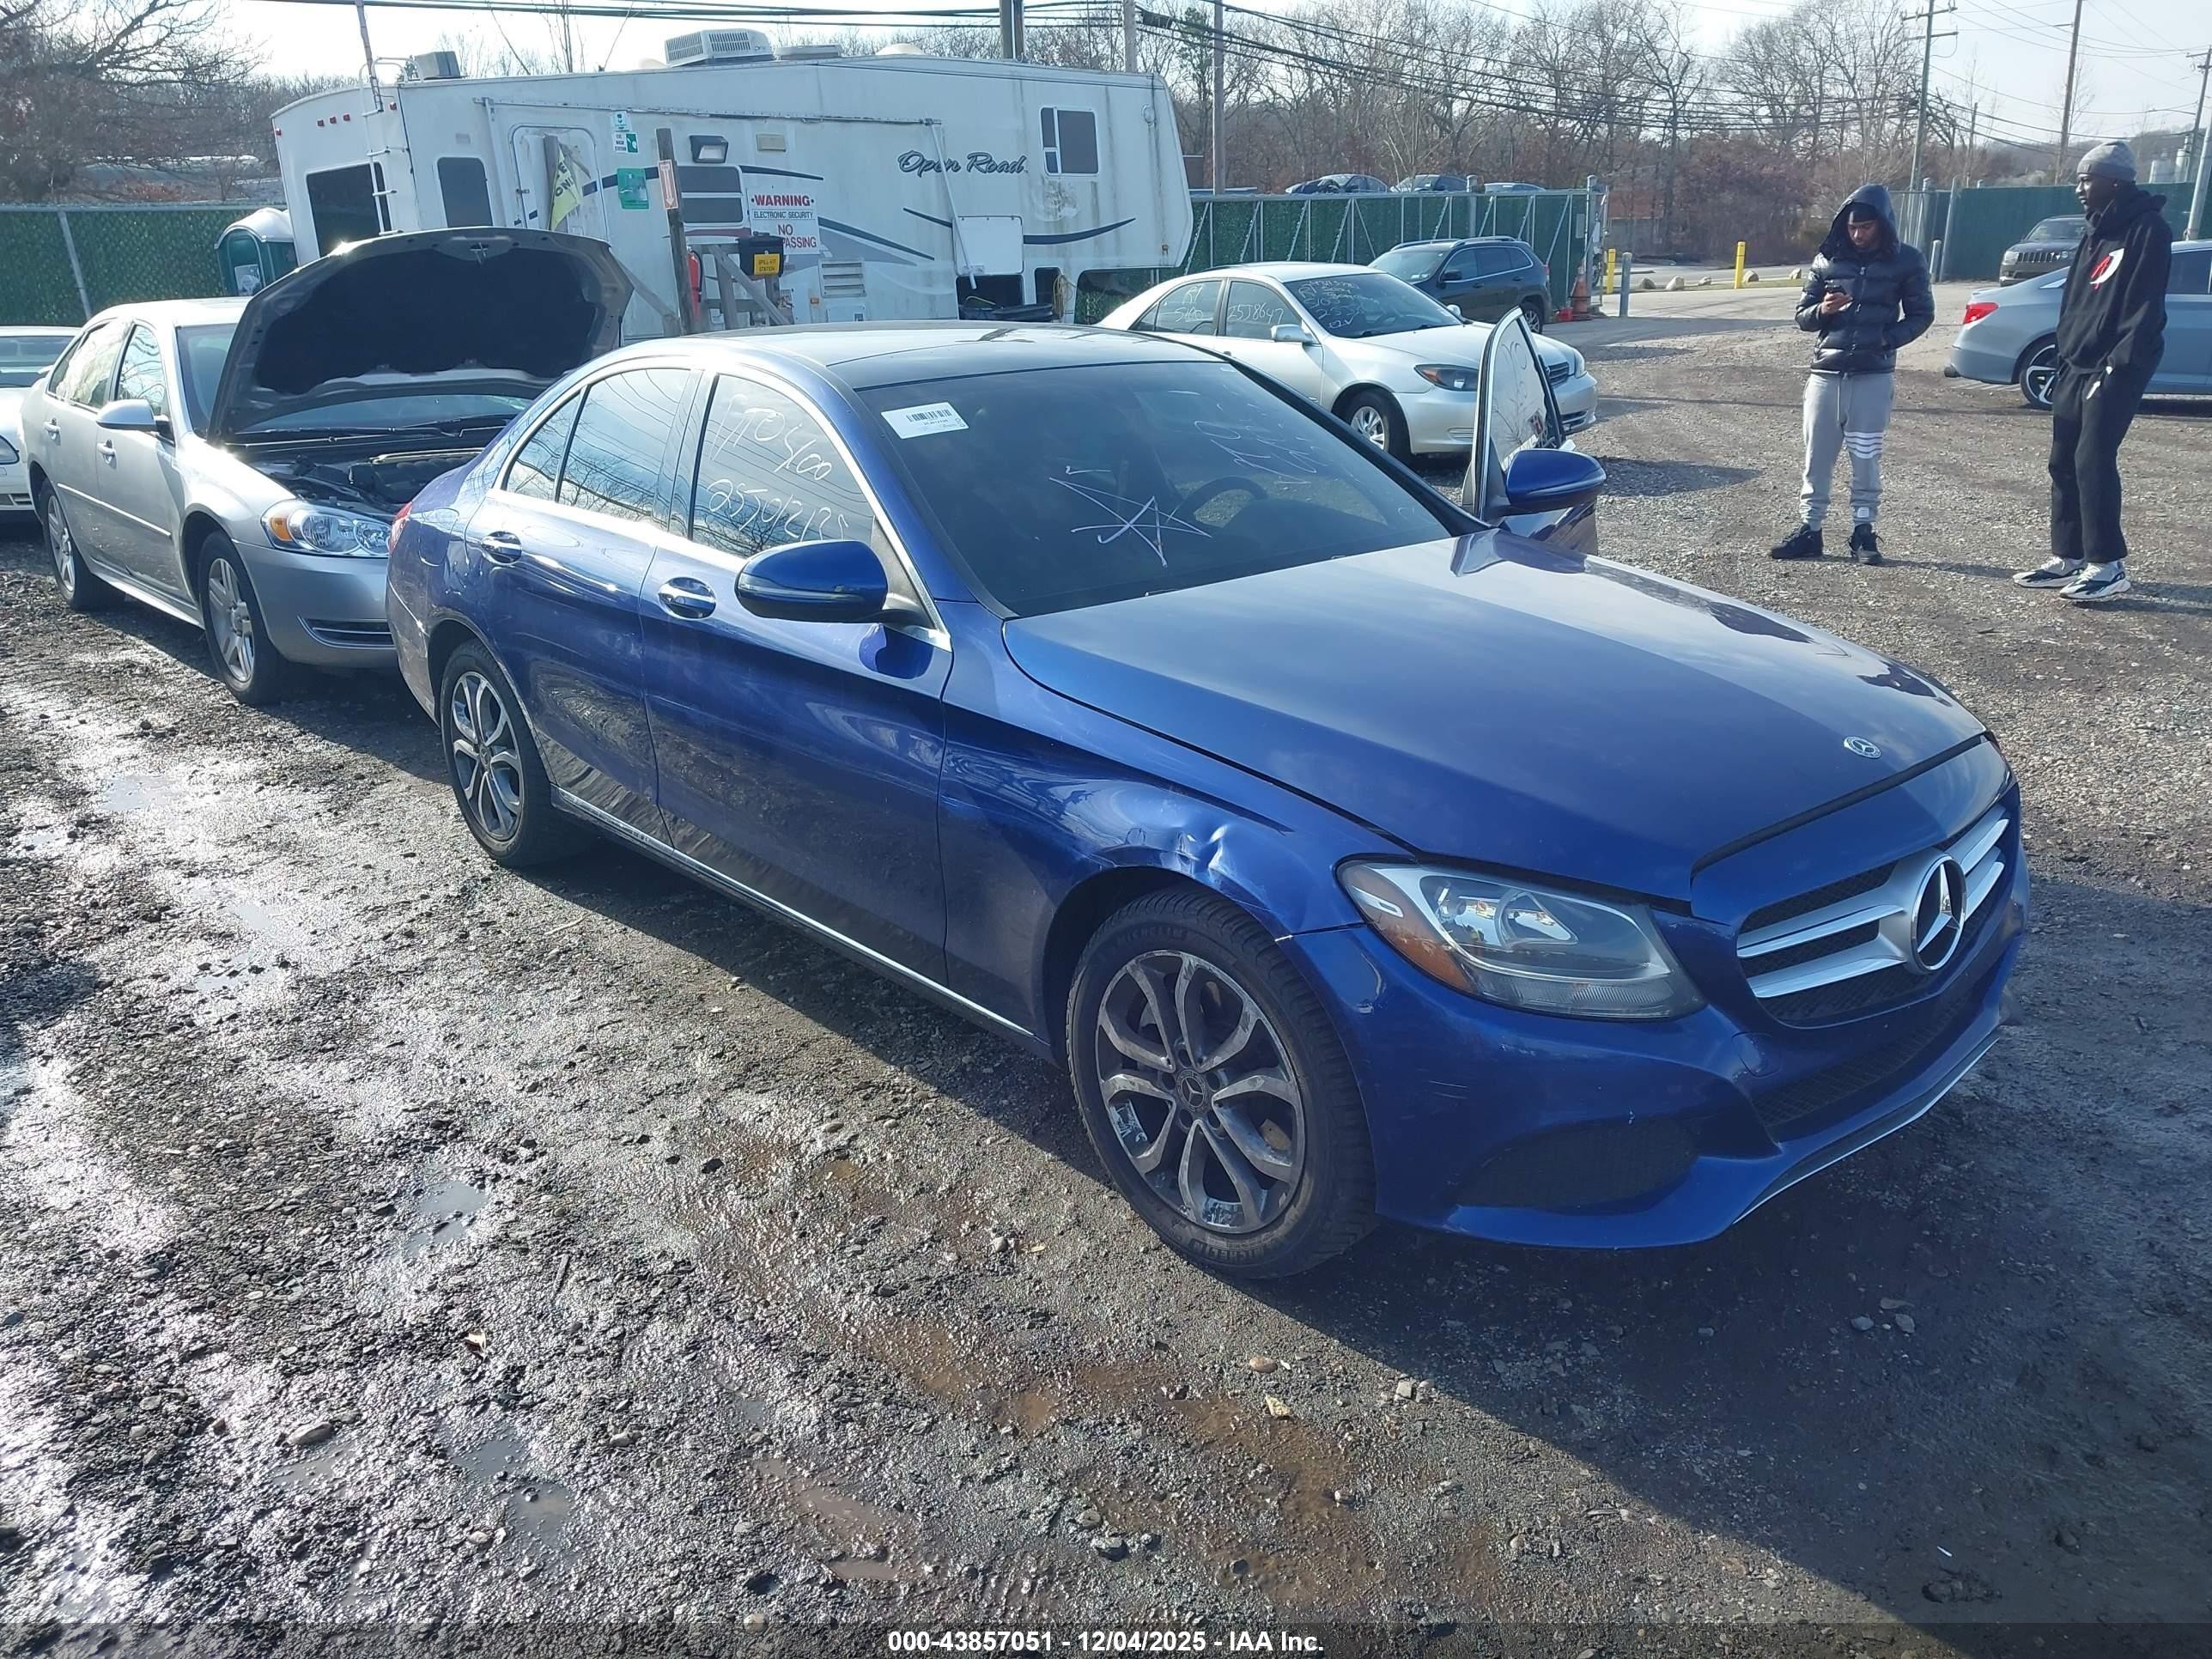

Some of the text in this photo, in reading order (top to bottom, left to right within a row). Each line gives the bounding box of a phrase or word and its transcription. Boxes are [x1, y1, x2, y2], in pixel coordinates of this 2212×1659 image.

[897, 149, 1028, 178] Open Road
[754, 194, 811, 207] WARNING
[753, 210, 786, 219] ELECTRONIC
[777, 223, 793, 235] NO
